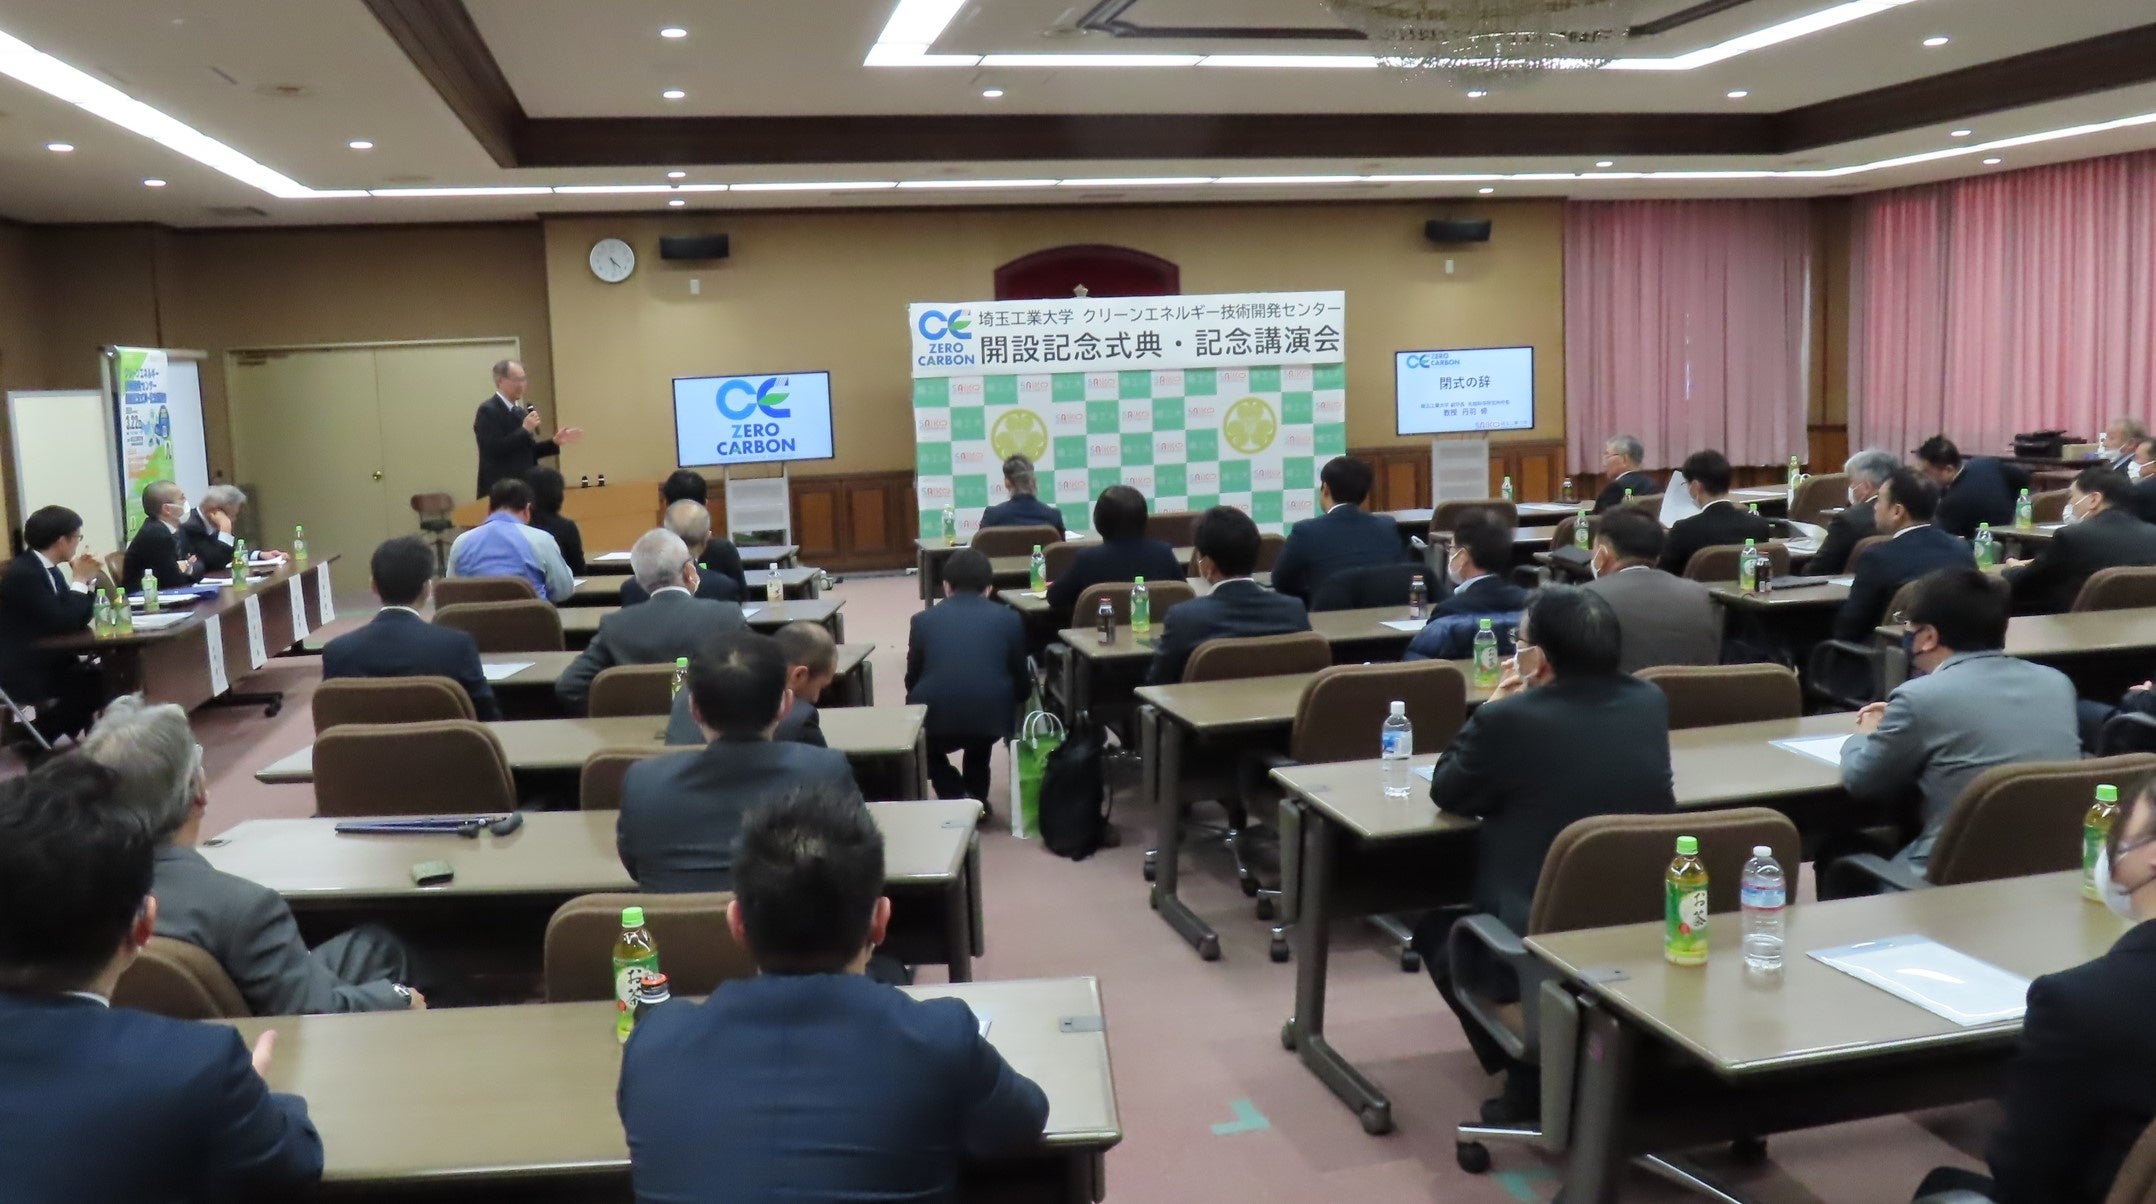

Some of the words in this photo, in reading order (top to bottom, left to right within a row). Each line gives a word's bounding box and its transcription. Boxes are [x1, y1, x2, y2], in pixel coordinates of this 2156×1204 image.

[978, 308, 1074, 328] 埼玉工業大学
[1083, 302, 1341, 324] クリーンエネルギー技術開発センター
[929, 342, 964, 354] ZERO
[981, 324, 1340, 364] 開設記念式典・記念講演会
[918, 354, 975, 366] CARBON
[1440, 375, 1490, 390] 閉式の辞
[731, 422, 780, 439] ZERO
[717, 438, 796, 456] CARBON
[627, 968, 643, 1006] お茶
